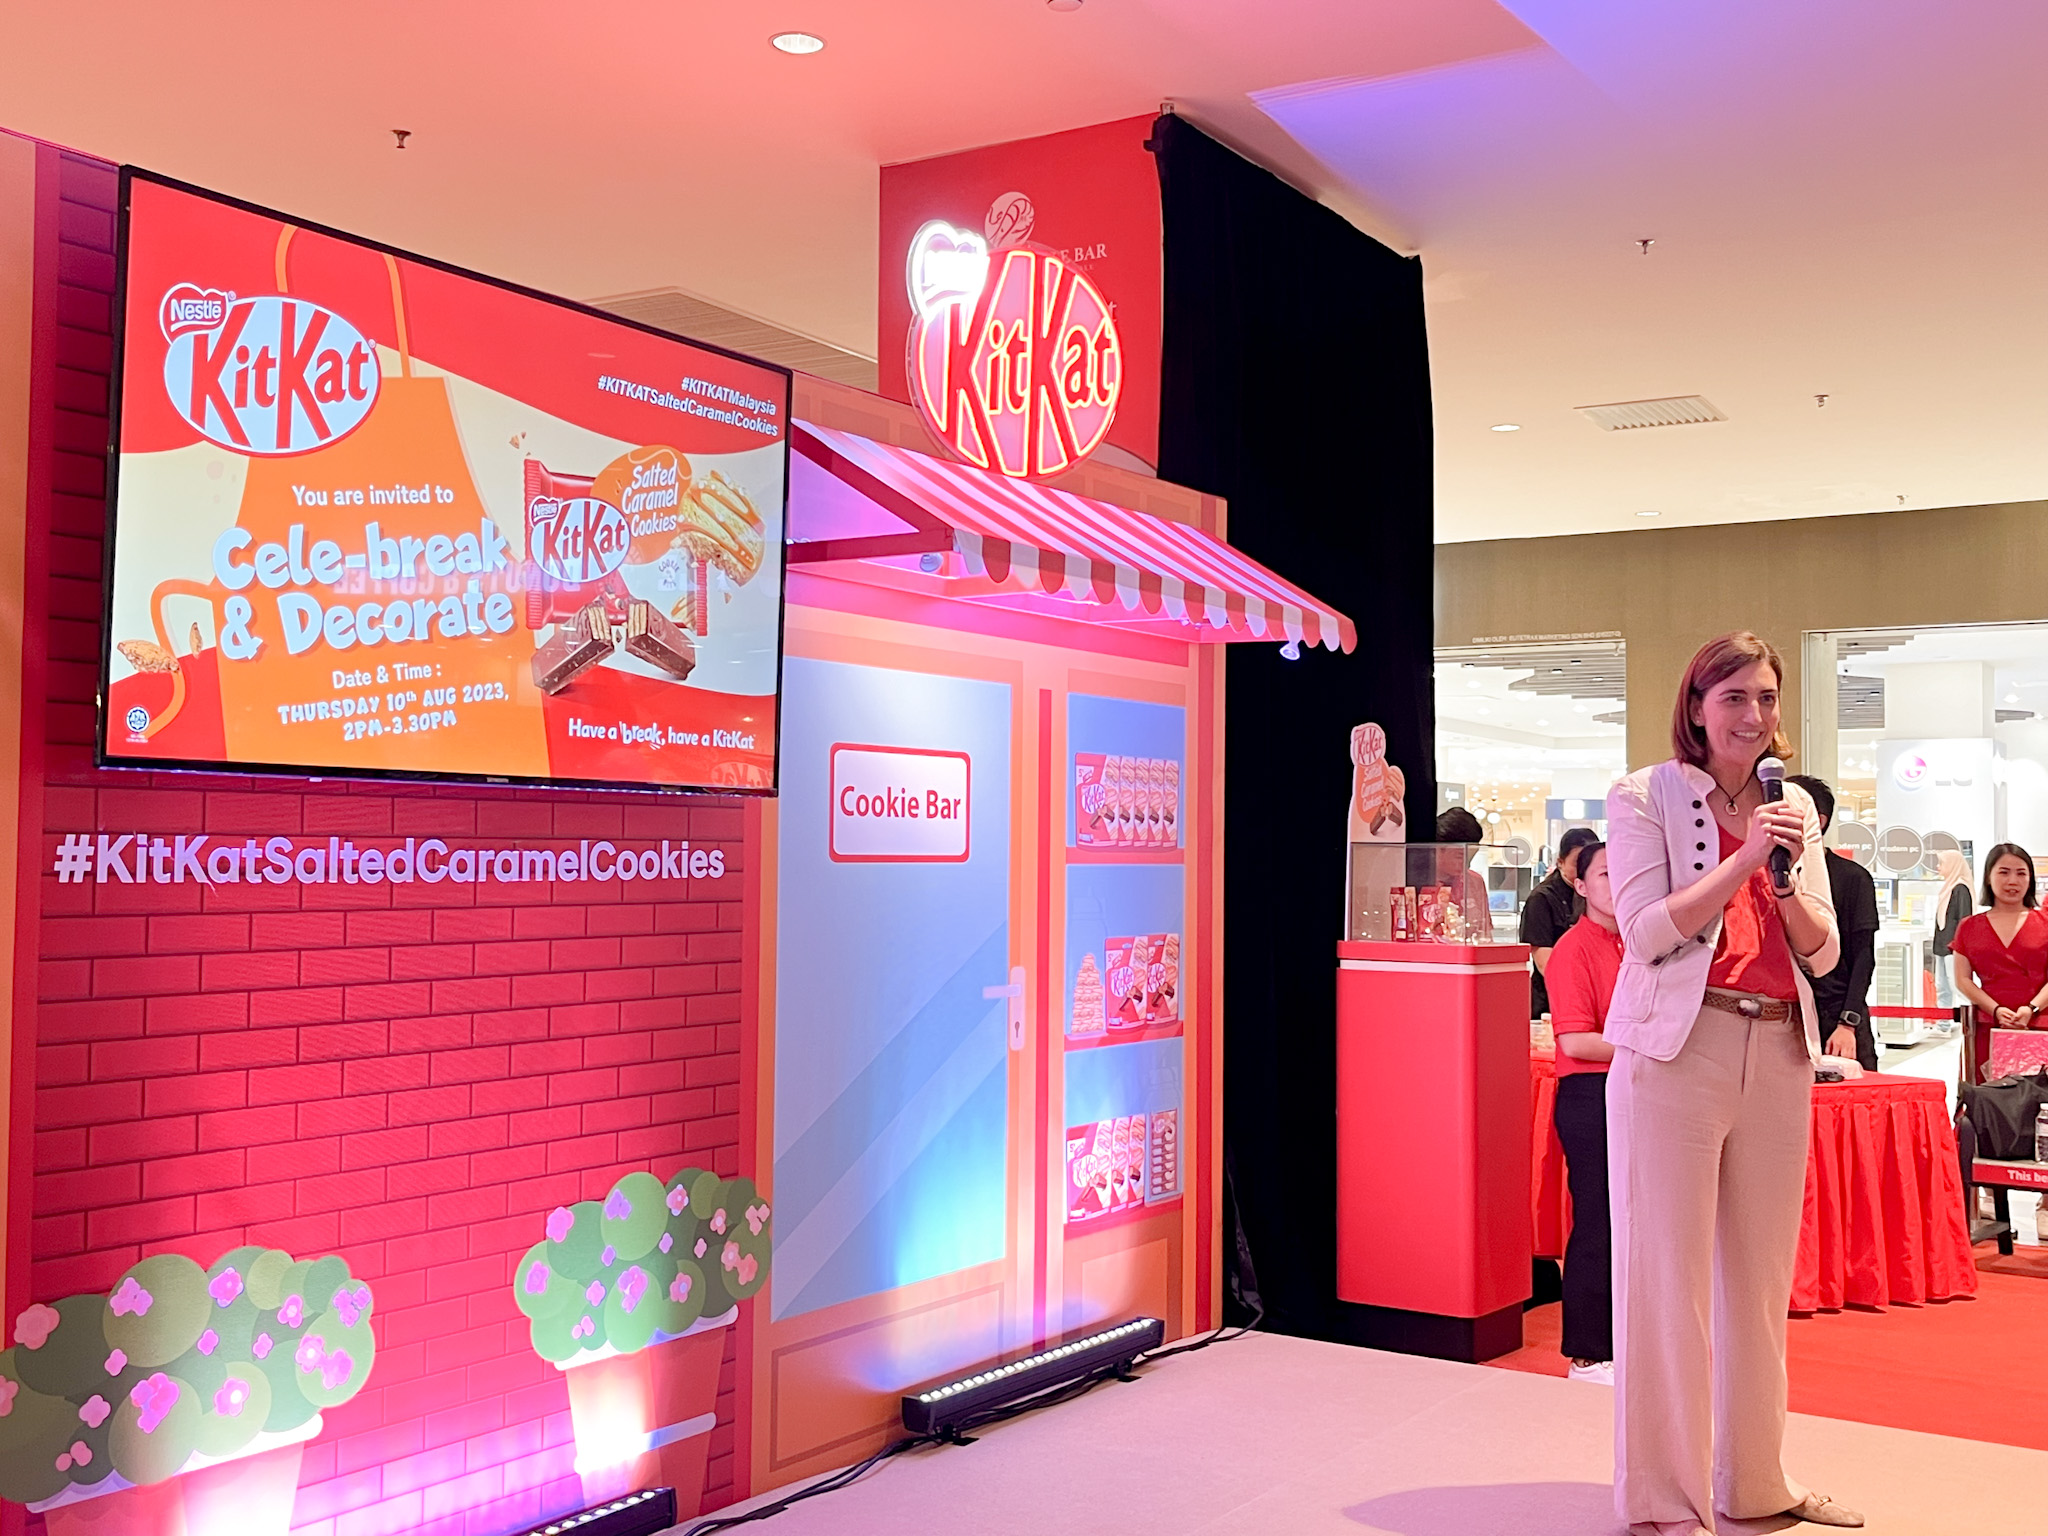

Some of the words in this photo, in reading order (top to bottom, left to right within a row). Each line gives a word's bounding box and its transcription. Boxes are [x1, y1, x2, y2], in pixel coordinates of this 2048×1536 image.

[1074, 243, 1107, 262] BAR
[189, 301, 369, 450] KitKat
[944, 249, 1118, 477] KitKat
[597, 374, 779, 437] #KITKATSaltedCaramelCookies
[681, 376, 777, 416] #KITKATMalaysia
[631, 459, 678, 490] Salted
[292, 485, 327, 506] You
[334, 489, 364, 505] are
[370, 484, 430, 504] invited
[435, 485, 454, 503] to
[622, 482, 679, 515] Caramel
[543, 500, 626, 581] KitKat
[631, 513, 677, 538] Cookies
[212, 517, 507, 590] Cele-break
[220, 596, 263, 659] &
[277, 579, 514, 655] Decorate
[332, 667, 372, 689] Date
[377, 665, 388, 683] &
[278, 697, 380, 725] THURSDAY
[387, 691, 417, 711] 10th
[423, 687, 456, 708] AUG
[463, 682, 509, 704] 2023,
[343, 710, 457, 741] 2PM-3.30PM
[568, 717, 605, 738] Have
[608, 727, 617, 739] a
[668, 726, 698, 745] have
[701, 734, 710, 746] a
[713, 729, 754, 749] KitKat
[840, 785, 919, 818] Cookie
[926, 789, 961, 819] Bar
[54, 834, 725, 885] #KitKatSaltedCaramelCookies
[1909, 846, 1919, 854] pc
[2007, 1169, 2031, 1181] This
